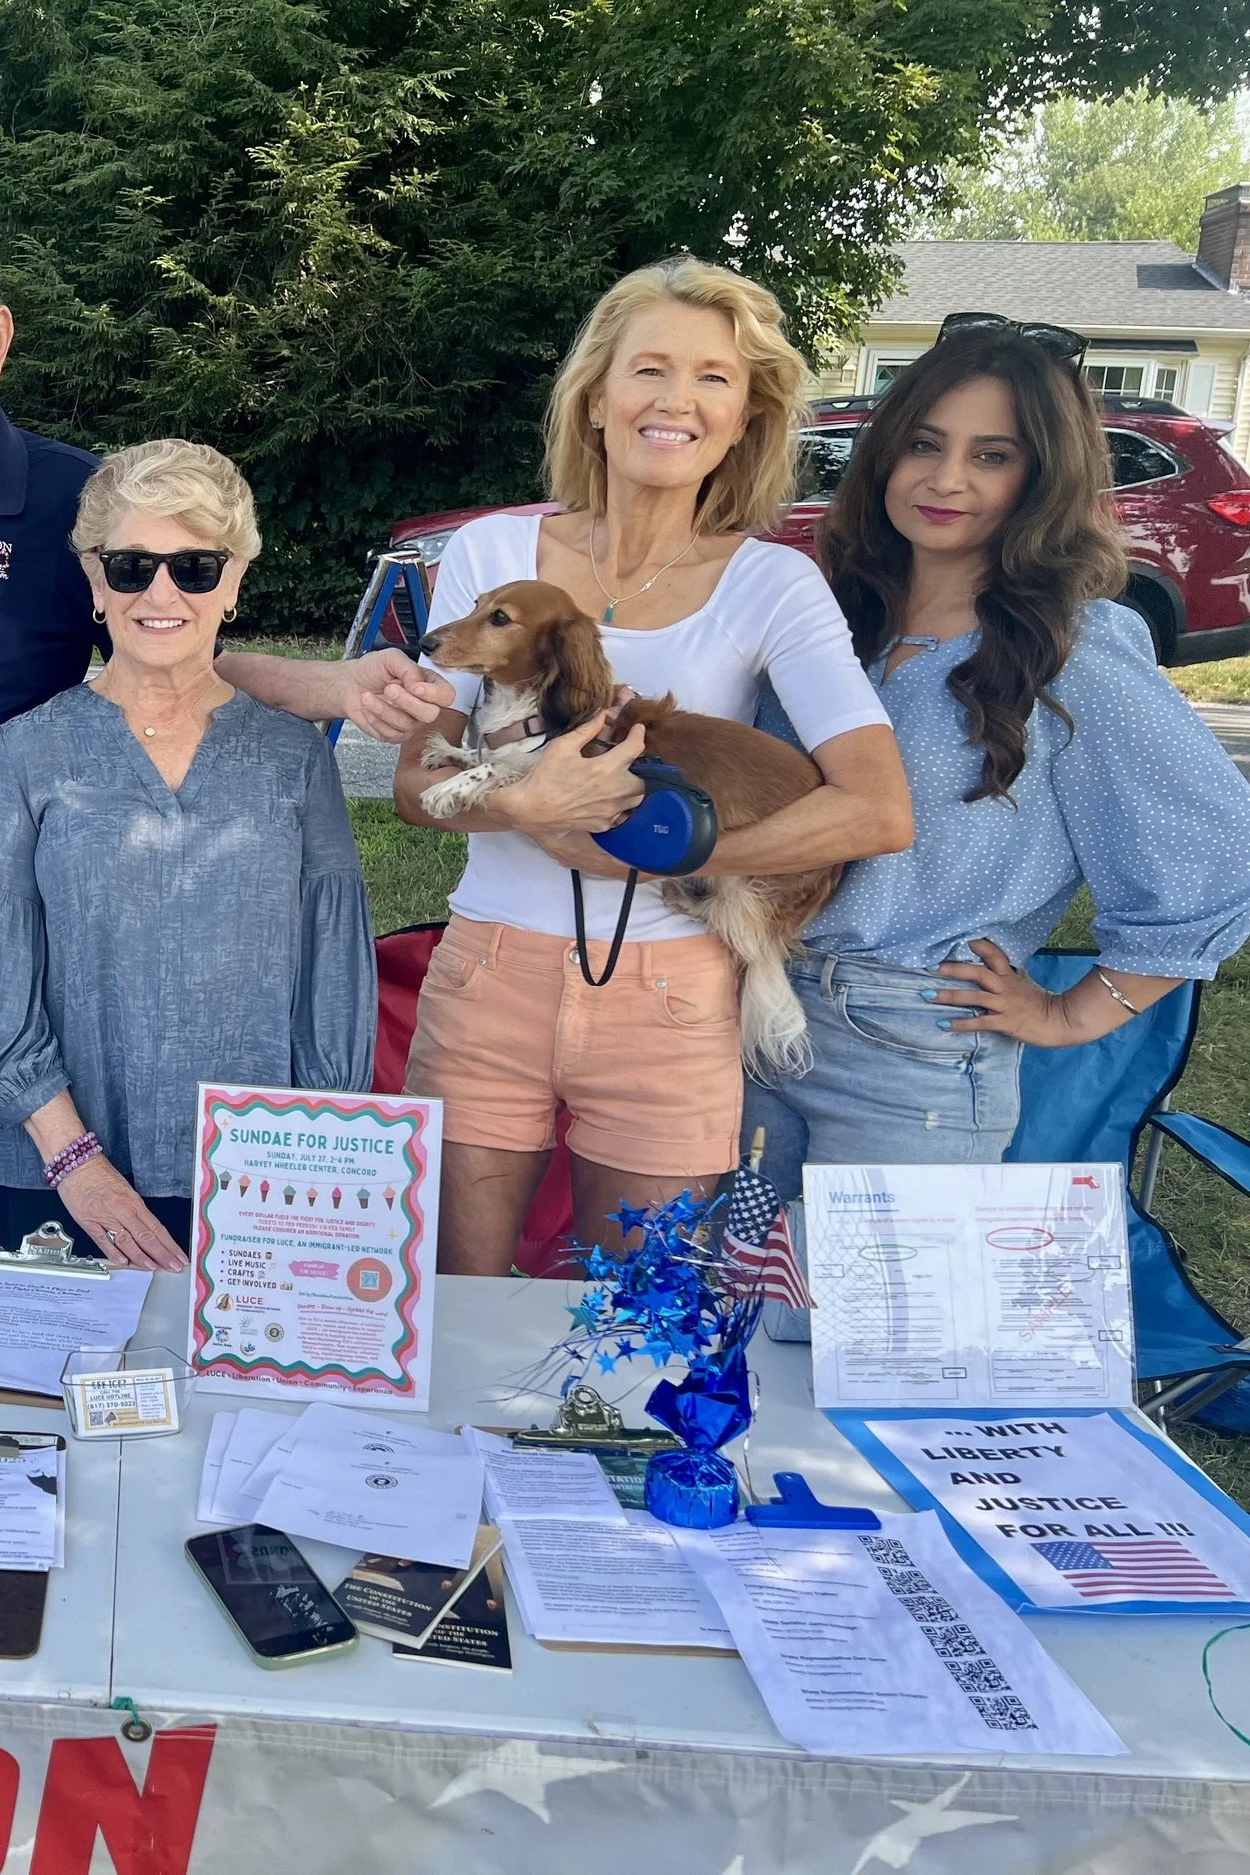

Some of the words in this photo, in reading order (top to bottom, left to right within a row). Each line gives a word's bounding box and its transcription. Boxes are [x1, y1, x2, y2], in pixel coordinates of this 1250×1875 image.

[230, 1128, 292, 1147] SUNDAE
[297, 1133, 327, 1150] FOR
[332, 1136, 394, 1155] JUSTICE
[266, 1151, 298, 1160] SUNDAY,
[299, 1154, 316, 1162] JULY
[344, 1157, 355, 1165] PM
[274, 1162, 307, 1171] WHEELER
[309, 1164, 339, 1174] CENTER,
[341, 1167, 377, 1176] CONCORD
[829, 1191, 896, 1204] Warrants
[272, 1226, 297, 1234] CONSIDER
[305, 1229, 334, 1237] ADDITIONAL
[335, 1231, 360, 1239] DONATION
[220, 1234, 261, 1244] FUNDRAISER
[262, 1237, 276, 1245] FOR
[297, 1240, 307, 1248] AN
[308, 1241, 360, 1253] IMMIGRANT-LED
[361, 1246, 393, 1255] NETWORK
[229, 1250, 262, 1259] SUNDAES
[245, 1261, 266, 1269] MUSIC
[227, 1269, 255, 1278] CRAFTS
[227, 1278, 240, 1286] GET
[242, 1279, 277, 1289] INVOLVED
[236, 1295, 264, 1305] LUCE
[91, 1381, 106, 1389] SEE
[109, 1379, 127, 1388] ICE?
[206, 1369, 226, 1378] LUCE
[232, 1373, 271, 1383] Liberation
[276, 1377, 298, 1385] Union
[304, 1379, 347, 1392] Community
[87, 1402, 105, 1410] (617)
[106, 1400, 136, 1408] 370-5023
[975, 1422, 1068, 1437] WITH
[921, 1446, 1067, 1461] LIBERTY
[950, 1471, 1022, 1485] AND
[975, 1496, 1128, 1511] JUSTICE
[996, 1523, 1078, 1538] FOR
[1084, 1522, 1154, 1538] ALL
[1154, 1522, 1196, 1537] !!!
[344, 1583, 362, 1591] THE
[363, 1587, 433, 1611] CONSTITUTION
[381, 1598, 397, 1606] THE
[346, 1594, 380, 1607] UNITED
[381, 1603, 413, 1617] STATES
[438, 1624, 499, 1636] NSTITUTION
[452, 1636, 488, 1646] STATES
